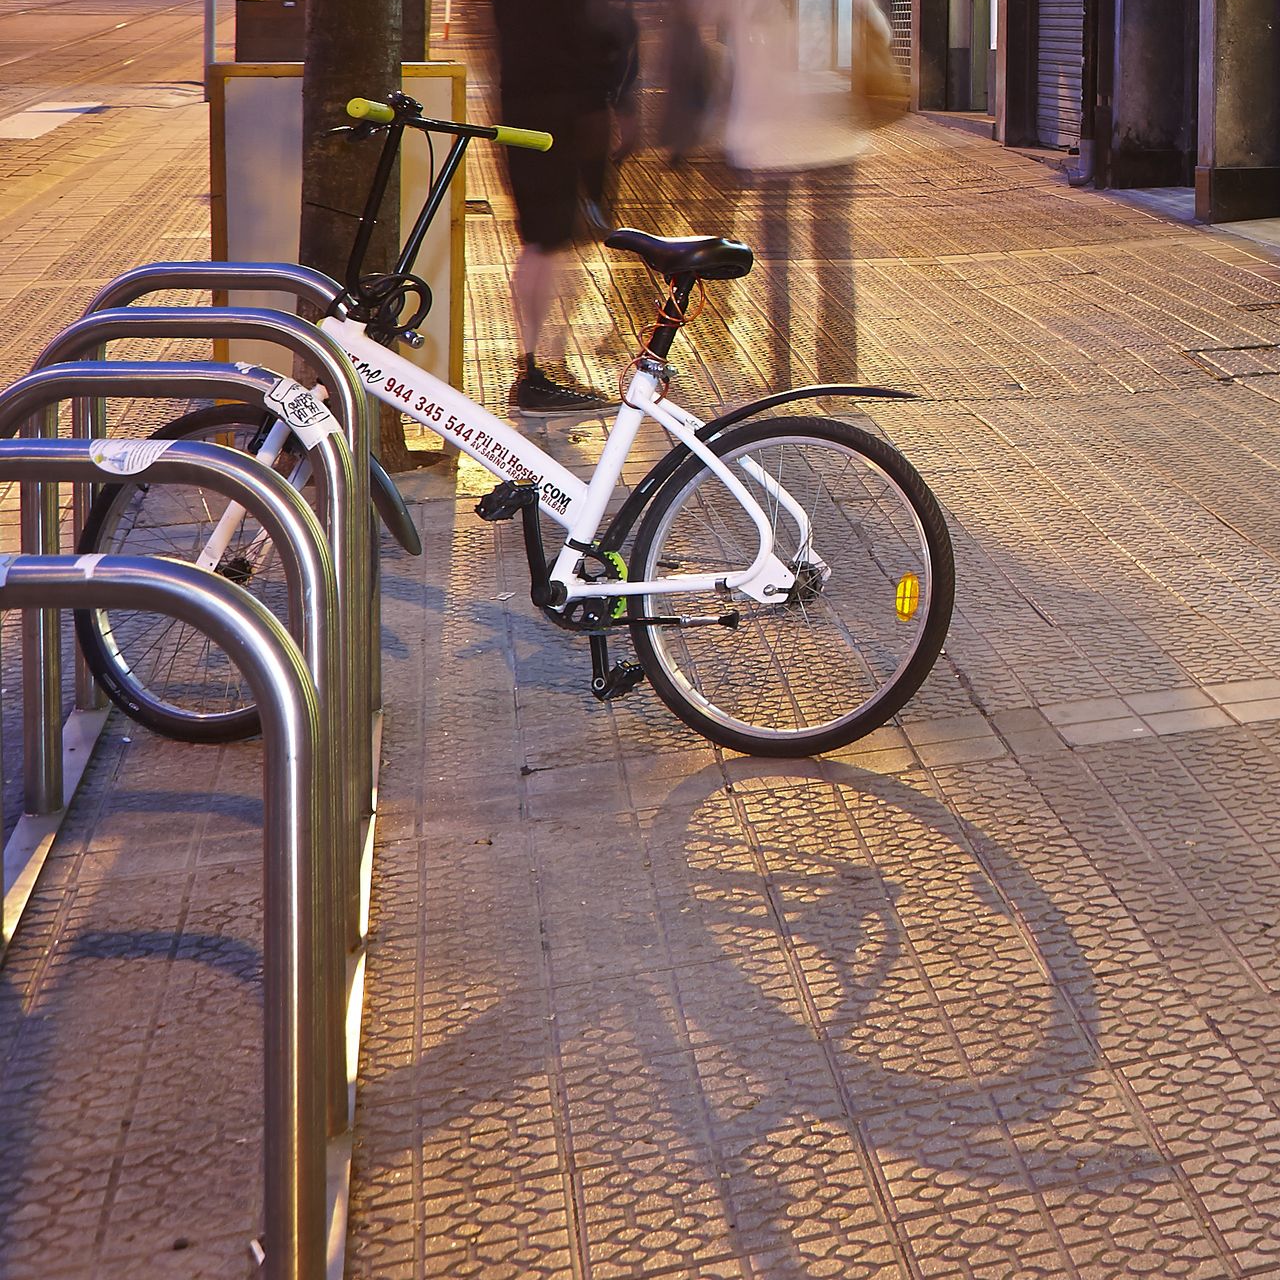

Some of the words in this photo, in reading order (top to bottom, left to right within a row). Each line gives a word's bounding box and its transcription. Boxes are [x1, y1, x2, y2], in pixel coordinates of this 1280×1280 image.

[384, 377, 413, 403] 944
[414, 396, 443, 422] 345
[445, 417, 475, 443] 544
[475, 431, 494, 448] Pil
[491, 443, 509, 460] Pil
[541, 493, 567, 515] BILBAO
